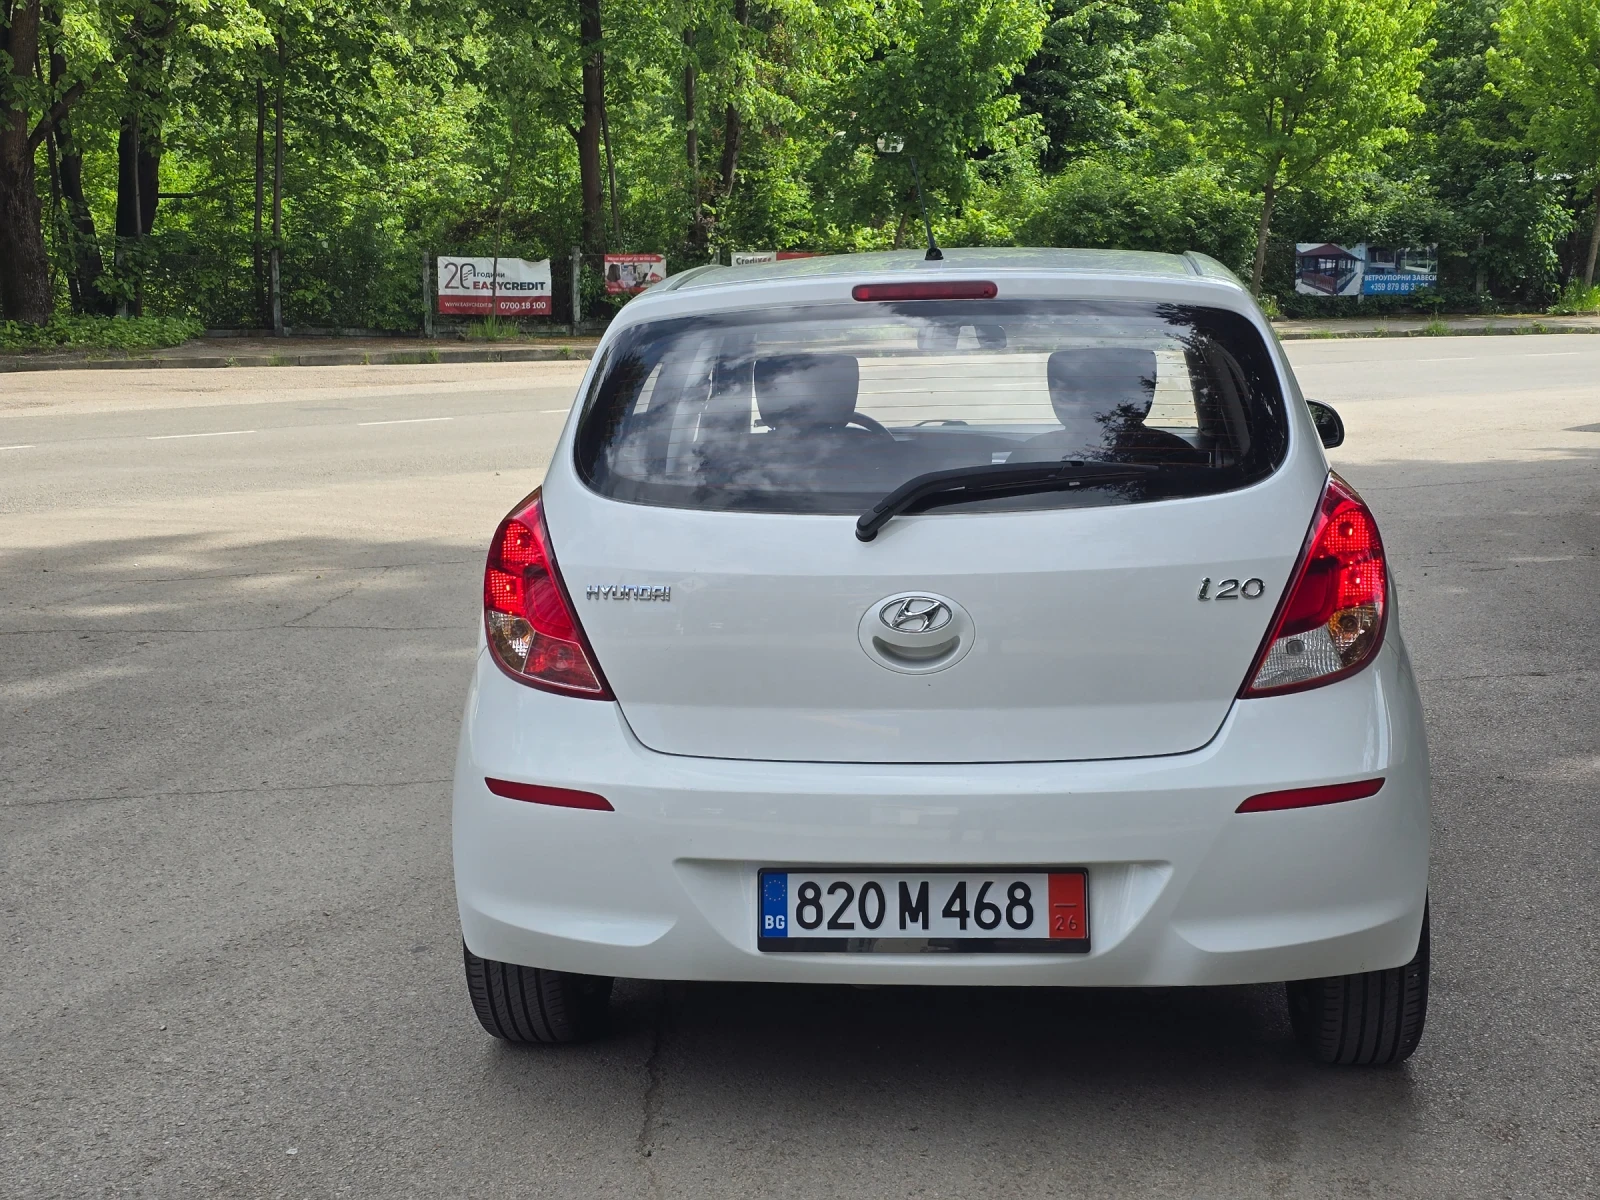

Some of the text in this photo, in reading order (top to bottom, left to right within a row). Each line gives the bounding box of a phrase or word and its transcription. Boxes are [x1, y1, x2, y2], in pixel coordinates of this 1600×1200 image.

[444, 262, 477, 290] 20
[473, 281, 546, 291] EASYCREDIT
[1371, 283, 1386, 291] +359
[1387, 283, 1400, 291] 879
[1401, 283, 1409, 291] 86
[500, 301, 546, 309] 0700 18 100
[586, 584, 671, 601] HYUNDAI
[1197, 577, 1265, 601] i20
[796, 881, 1034, 930] 820 M 468
[764, 914, 785, 930] BG
[1054, 914, 1078, 931] 26
